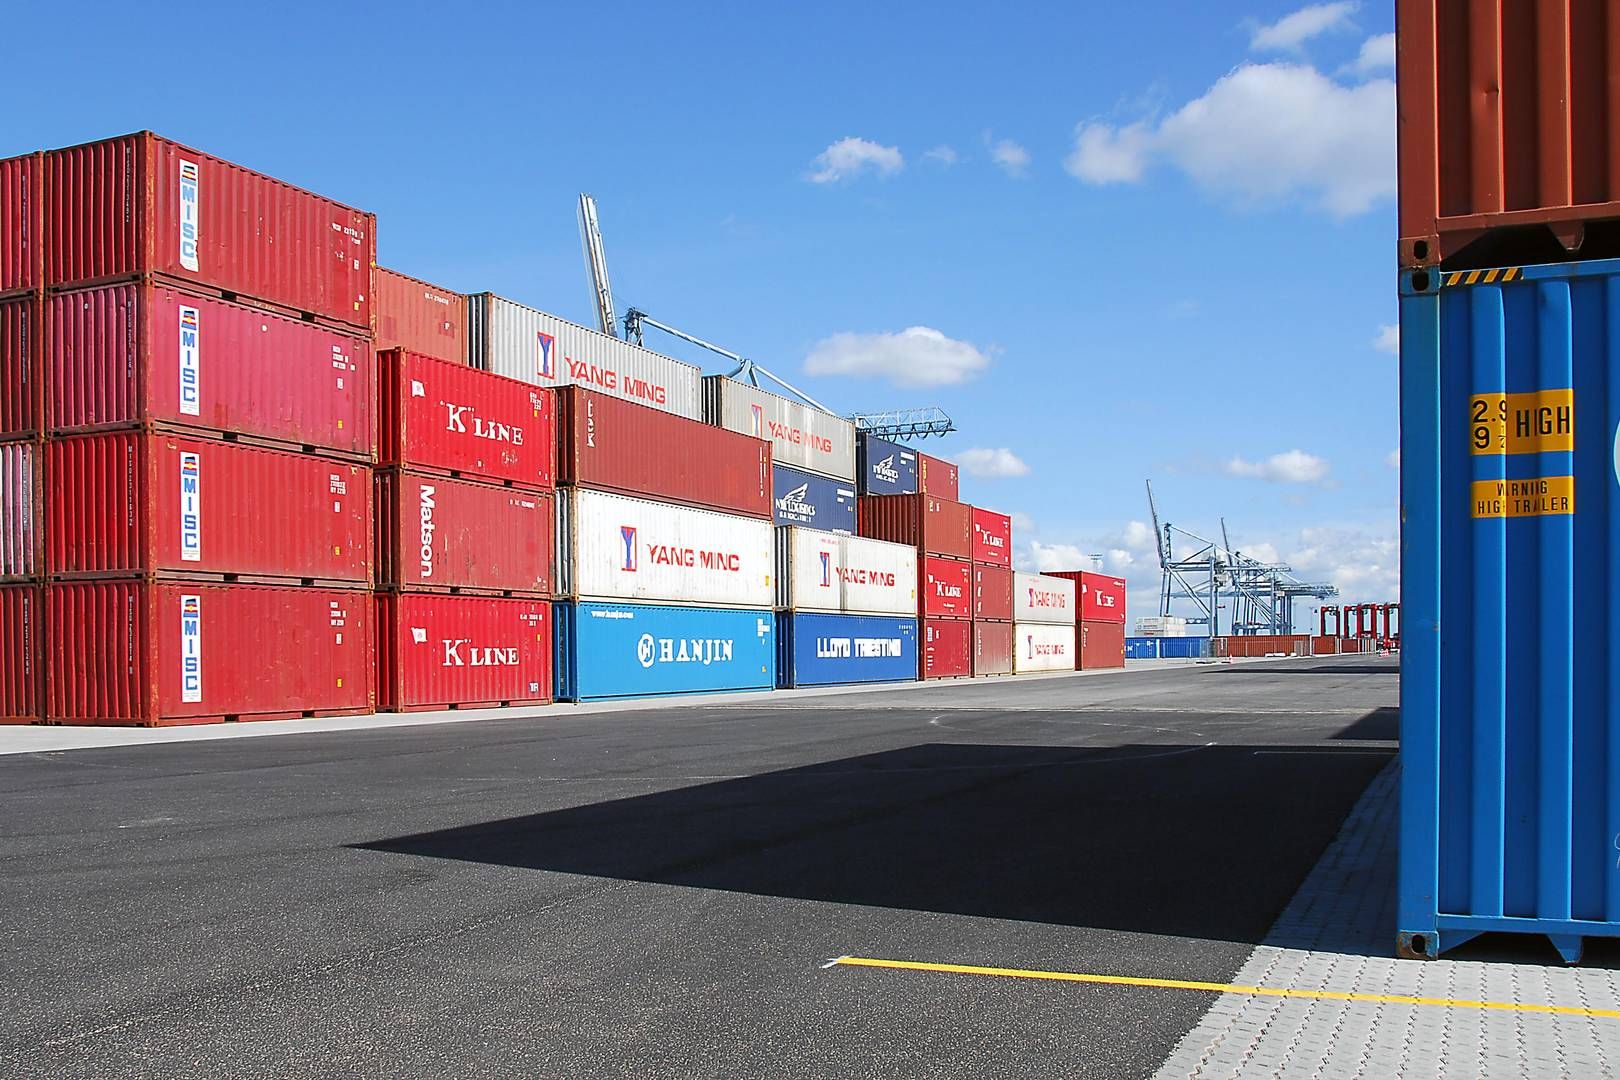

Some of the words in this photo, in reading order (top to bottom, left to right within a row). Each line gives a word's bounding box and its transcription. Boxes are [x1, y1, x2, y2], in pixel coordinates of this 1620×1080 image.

[182, 184, 195, 258] MISC
[183, 330, 196, 403] MISC
[565, 356, 616, 389] YANG
[624, 375, 665, 404] MING
[473, 417, 524, 446] LINE
[768, 420, 801, 445] YANG
[1516, 406, 1570, 438] HIGH
[184, 477, 197, 549] MISC
[420, 484, 436, 578] Matson
[646, 543, 695, 568] YANG
[868, 570, 895, 587] MNG
[185, 620, 198, 691] MISC
[469, 647, 520, 666] LINE
[658, 638, 734, 665] HANJIN
